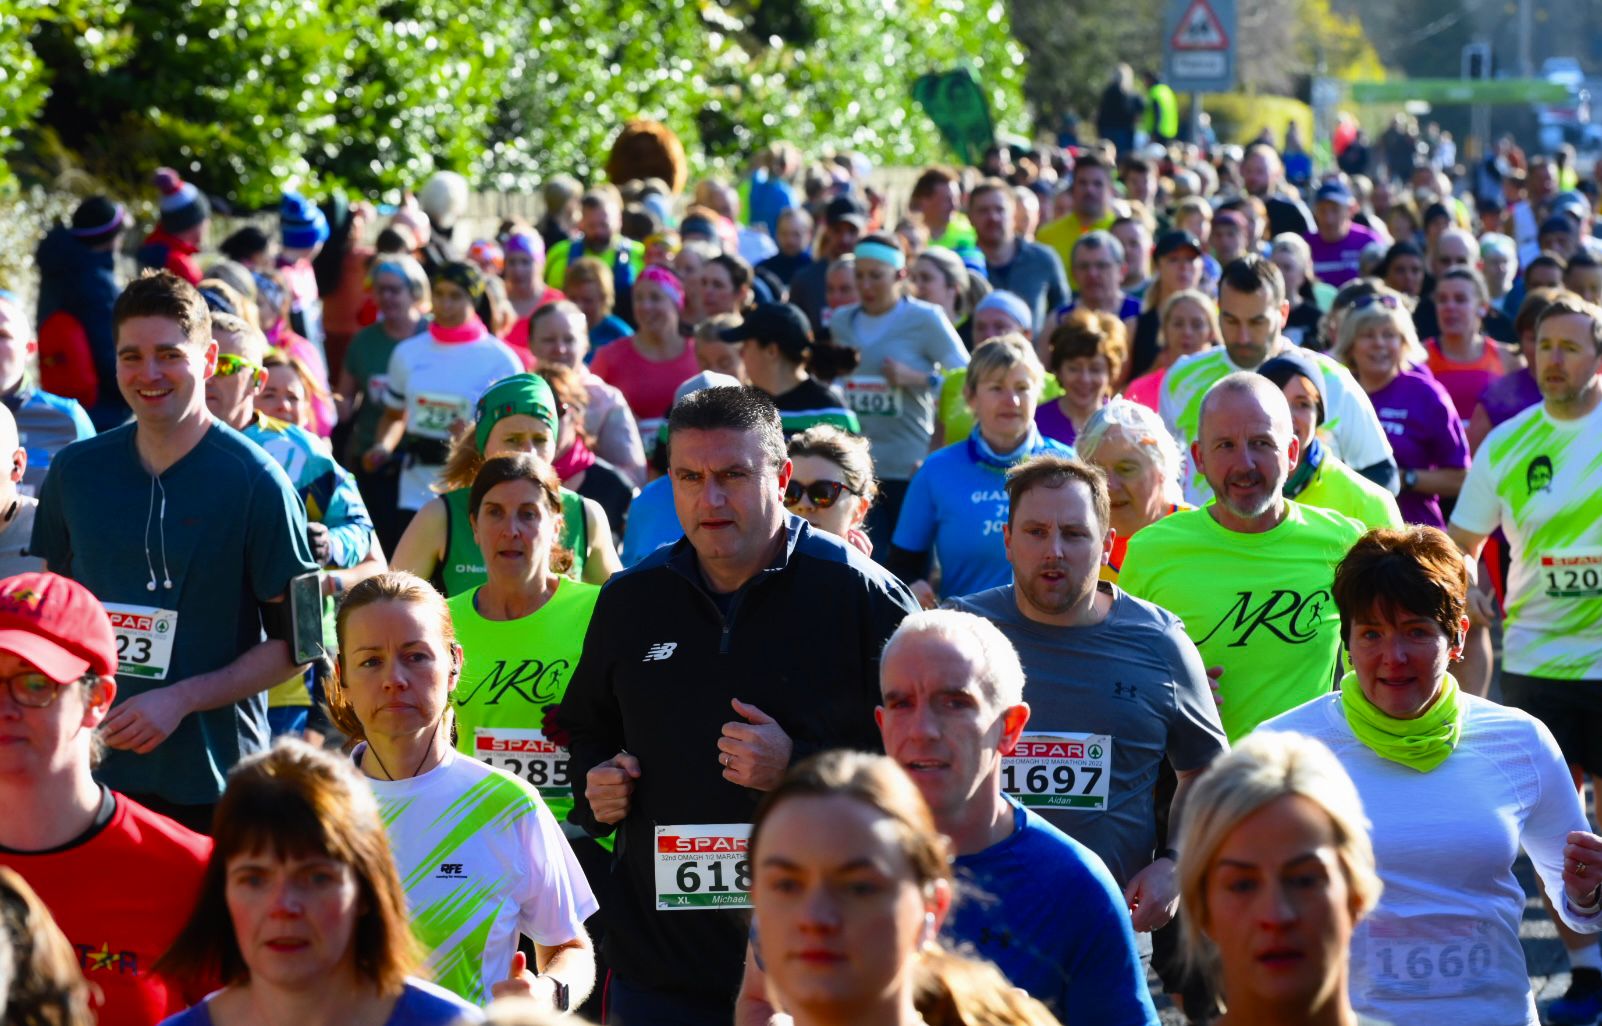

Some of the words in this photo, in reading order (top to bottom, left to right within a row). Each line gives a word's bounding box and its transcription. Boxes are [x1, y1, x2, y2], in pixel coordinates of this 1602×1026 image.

[983, 520, 1008, 536] JO
[1546, 569, 1599, 590] 120
[109, 614, 151, 630] PAR
[115, 634, 152, 664] 23
[491, 740, 556, 752] SPAR
[1015, 744, 1083, 757] SPAR
[1002, 765, 1103, 794] 1697
[1047, 796, 1072, 805] Aidan
[676, 837, 749, 852] SPAR
[440, 863, 464, 875] RFE
[676, 861, 752, 893] 618
[677, 896, 691, 905] XL
[711, 894, 747, 904] Michael
[1375, 943, 1491, 980] 1660
